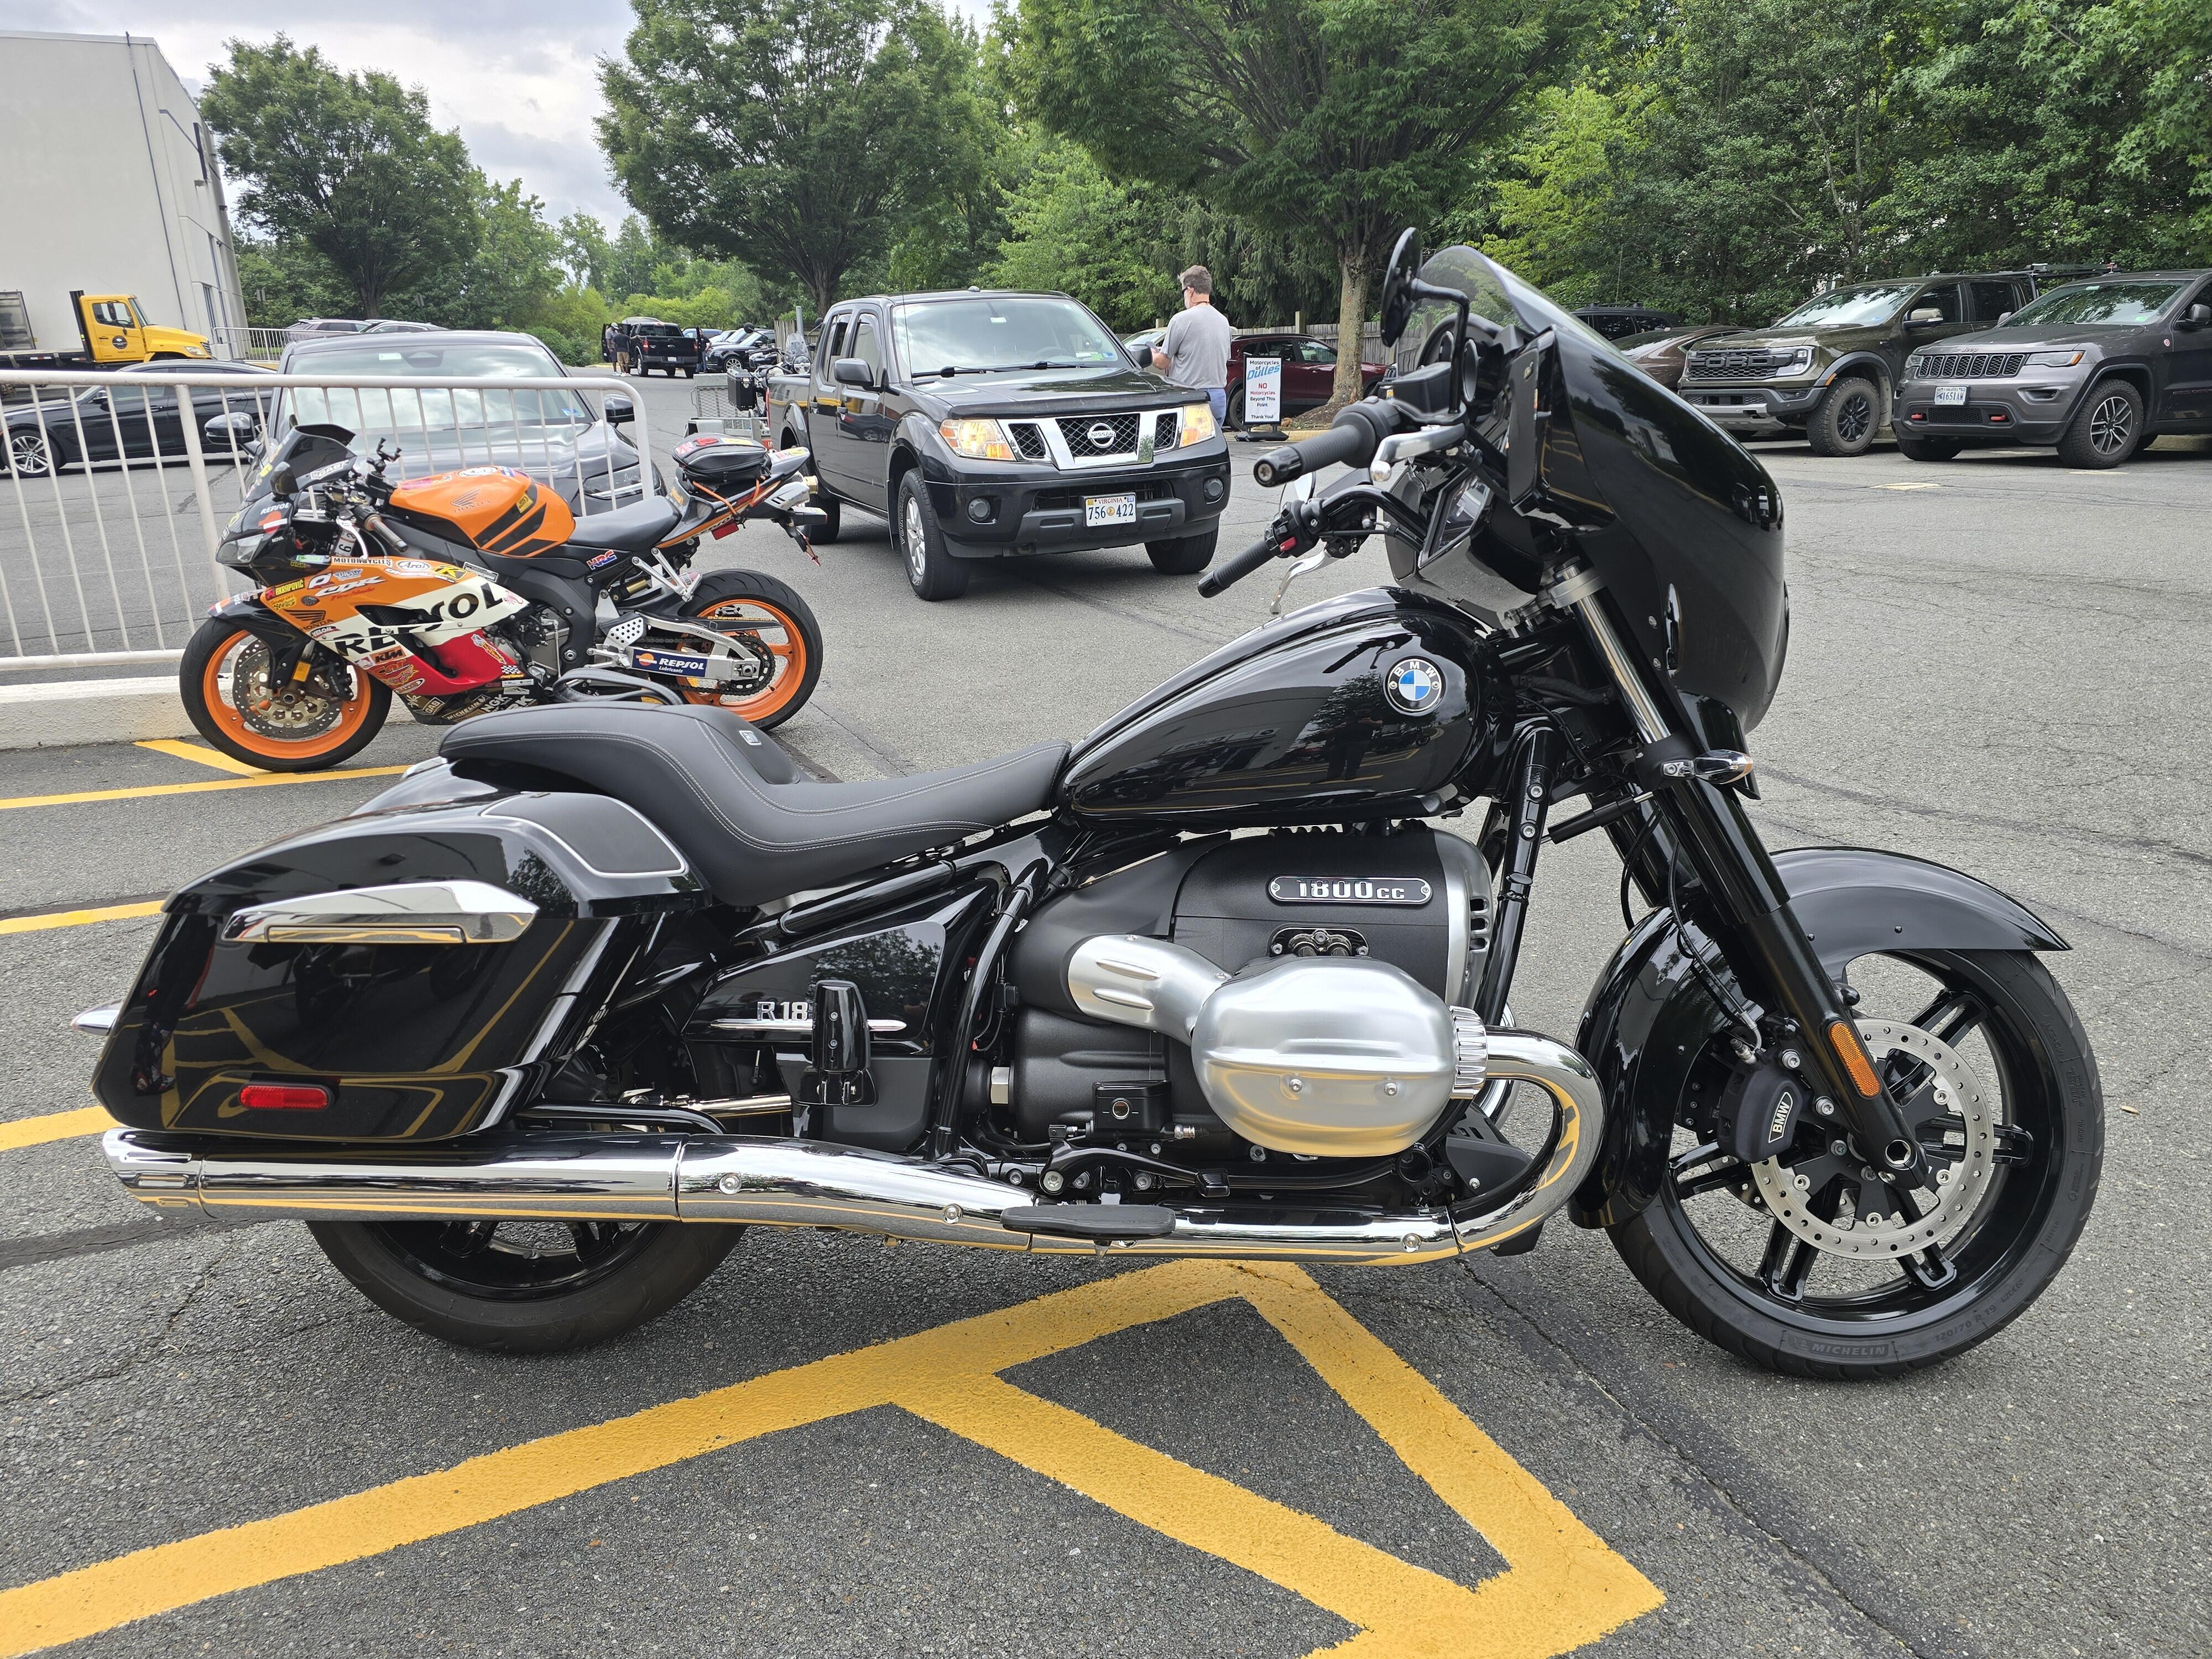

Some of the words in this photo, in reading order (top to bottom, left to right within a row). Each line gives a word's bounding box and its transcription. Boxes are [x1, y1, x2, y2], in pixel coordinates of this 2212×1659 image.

[1688, 356, 1773, 367] FORD
[1247, 365, 1280, 380] Dulles
[260, 503, 289, 515] REPSOL
[453, 500, 491, 513] HONDA
[1088, 506, 1106, 520] 756
[1117, 503, 1134, 518] 422
[333, 557, 392, 566] MOTORYCLES
[586, 549, 618, 570] HRC
[315, 575, 387, 597] CBR
[300, 619, 335, 632] HONDA
[375, 649, 403, 663] KTM
[659, 658, 704, 670] REPSOL
[1393, 661, 1437, 678] BMW
[447, 701, 480, 720] MICHELIN
[481, 694, 509, 712] NGK
[1296, 879, 1405, 900] 1800cc
[757, 1001, 775, 1021] R
[780, 1001, 808, 1021] 18
[1772, 1100, 1790, 1133] BMW
[1936, 1320, 1972, 1342] 120/70
[1975, 1314, 1983, 1323] R
[1984, 1305, 1996, 1316] 19
[1811, 1343, 1885, 1355] MICHELIN
